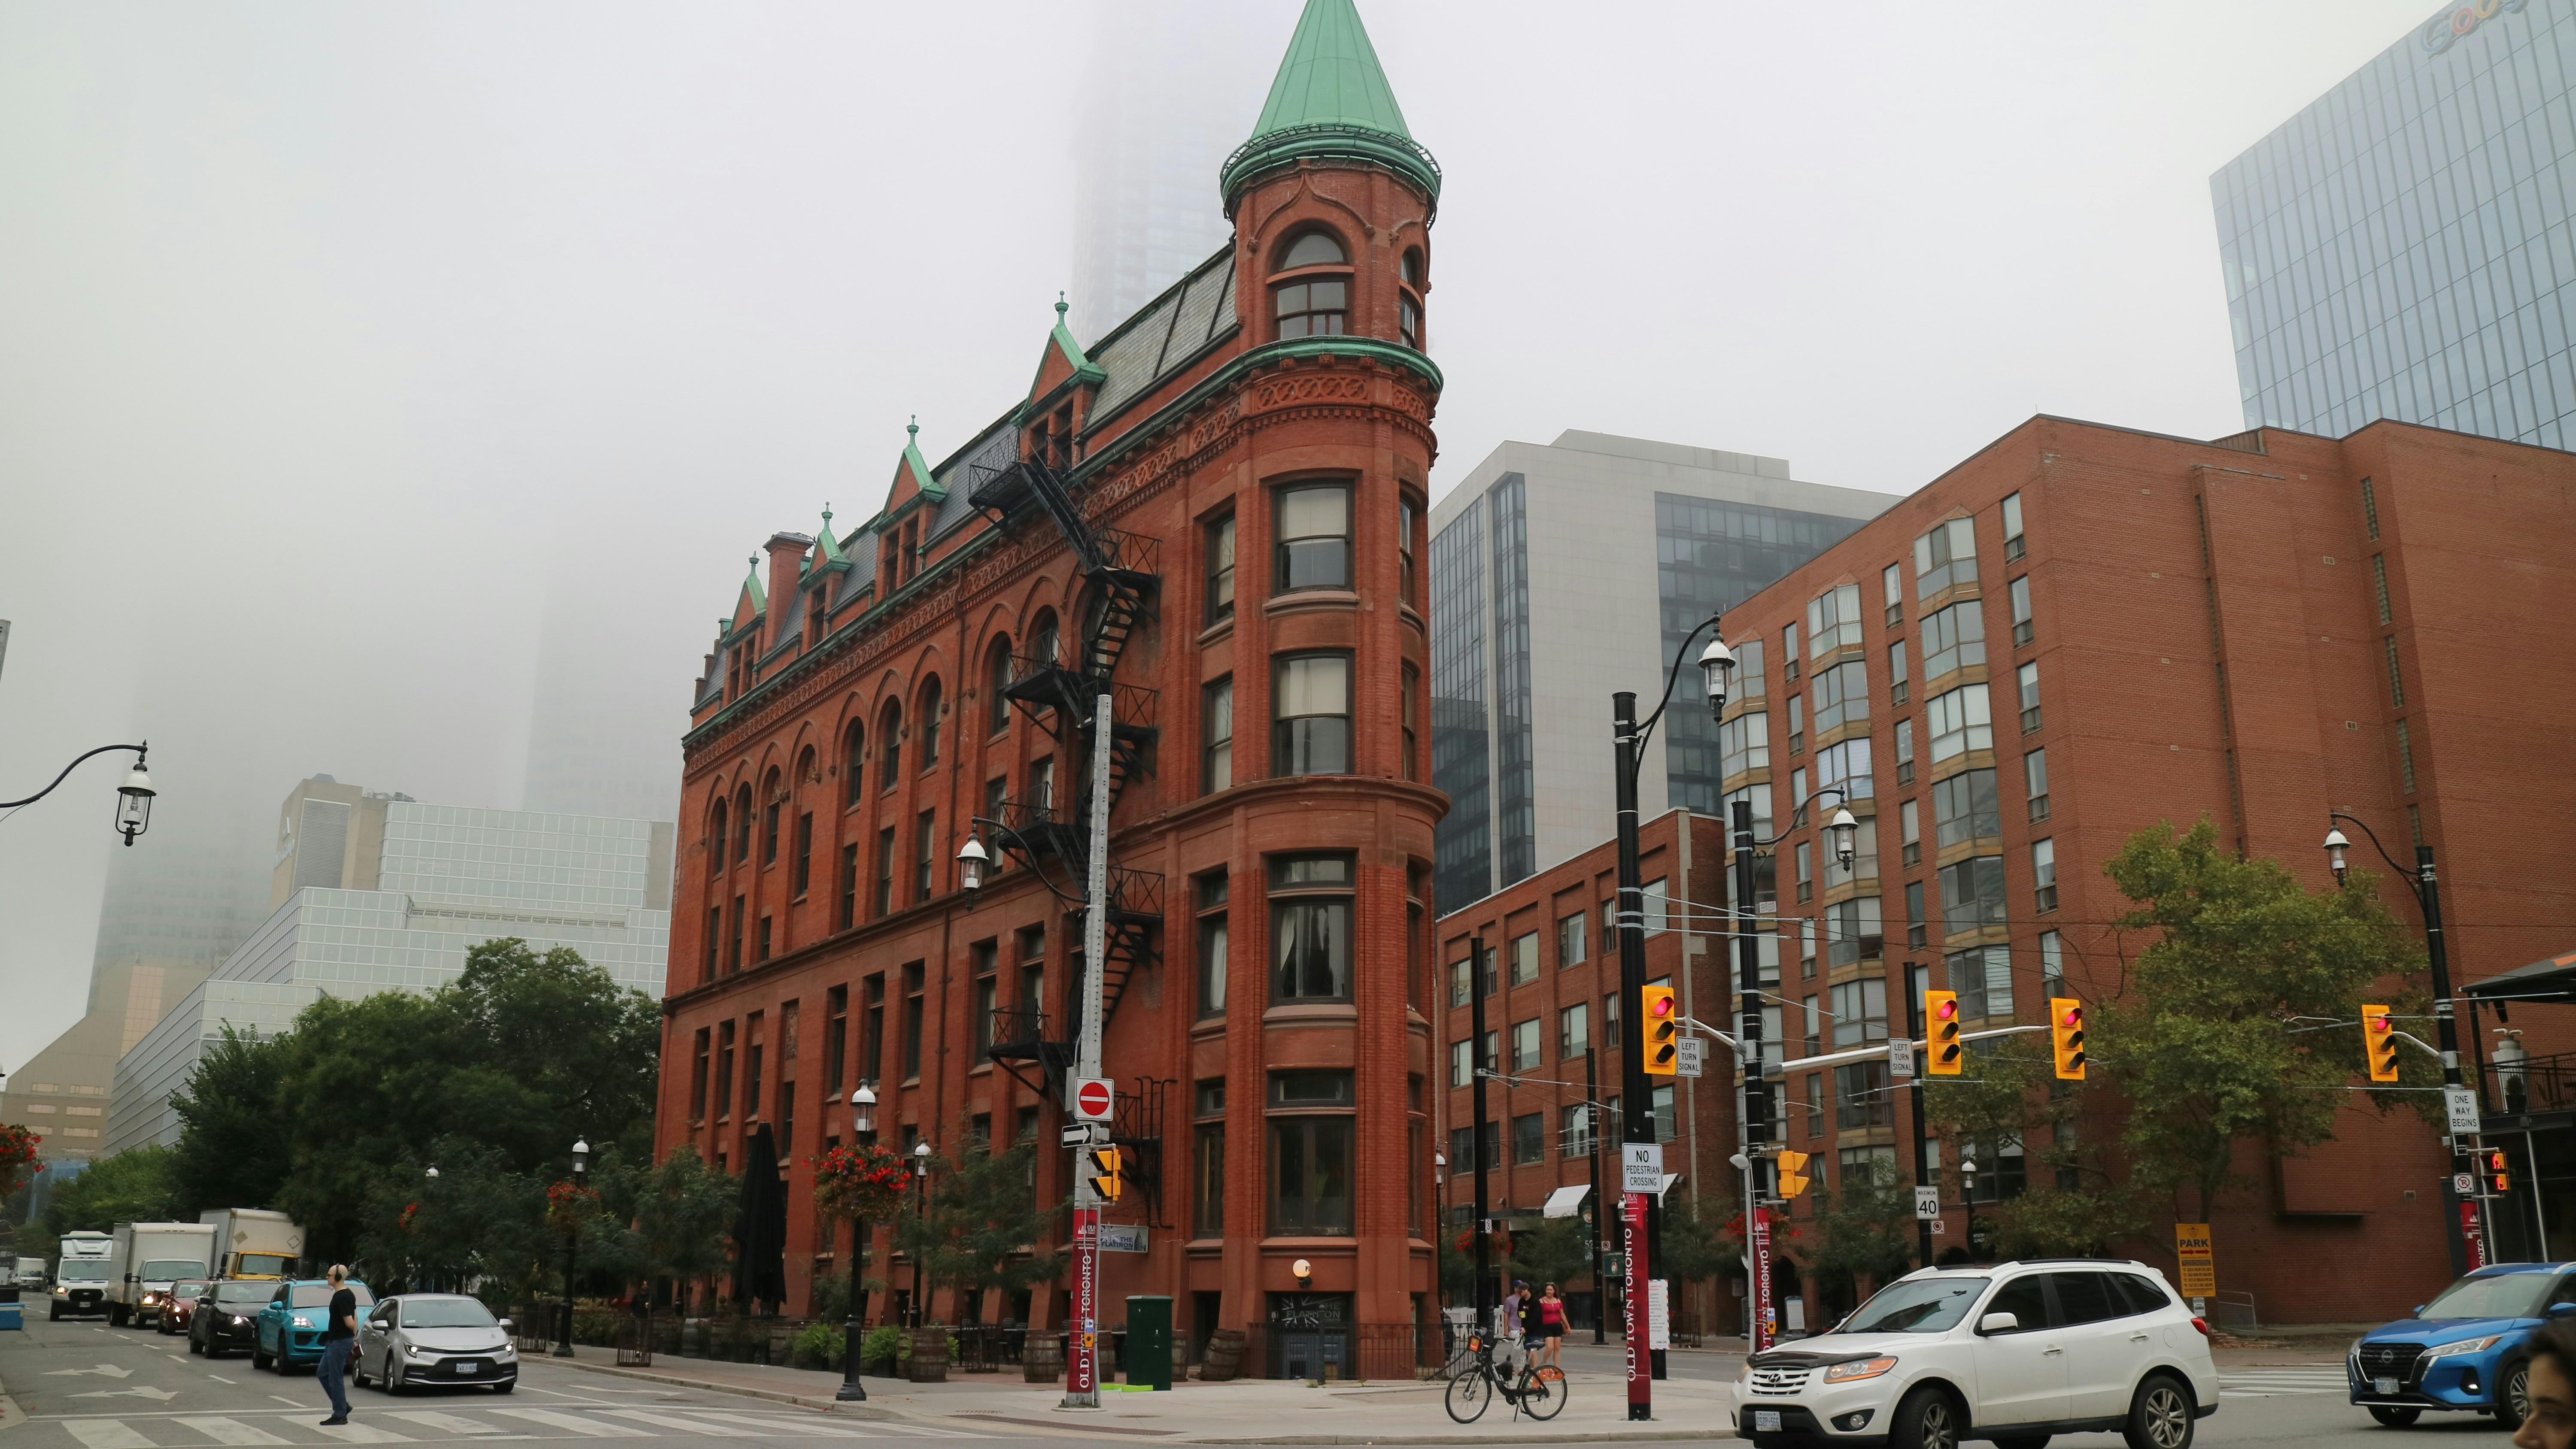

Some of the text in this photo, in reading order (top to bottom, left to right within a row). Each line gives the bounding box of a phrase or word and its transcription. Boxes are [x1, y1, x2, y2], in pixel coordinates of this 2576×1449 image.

[1679, 1063, 1699, 1071] SIGNAL
[2452, 1119, 2477, 1127] BEGINS
[1636, 1150, 1649, 1162] NO
[1626, 1165, 1660, 1174] PEDESTRIAN
[1630, 1177, 1657, 1186] CROSSING
[1919, 1200, 1936, 1214] 40
[2179, 1239, 2209, 1248] PARK
[2477, 1239, 2486, 1267] ONTO
[1625, 1228, 1633, 1295] TORONTO
[1081, 1255, 1091, 1313] TORONTO
[1761, 1250, 1770, 1304] TORONTO
[1626, 1299, 1635, 1344] TOWN
[1079, 1358, 1090, 1388] OLD
[1627, 1347, 1636, 1382] OLD
